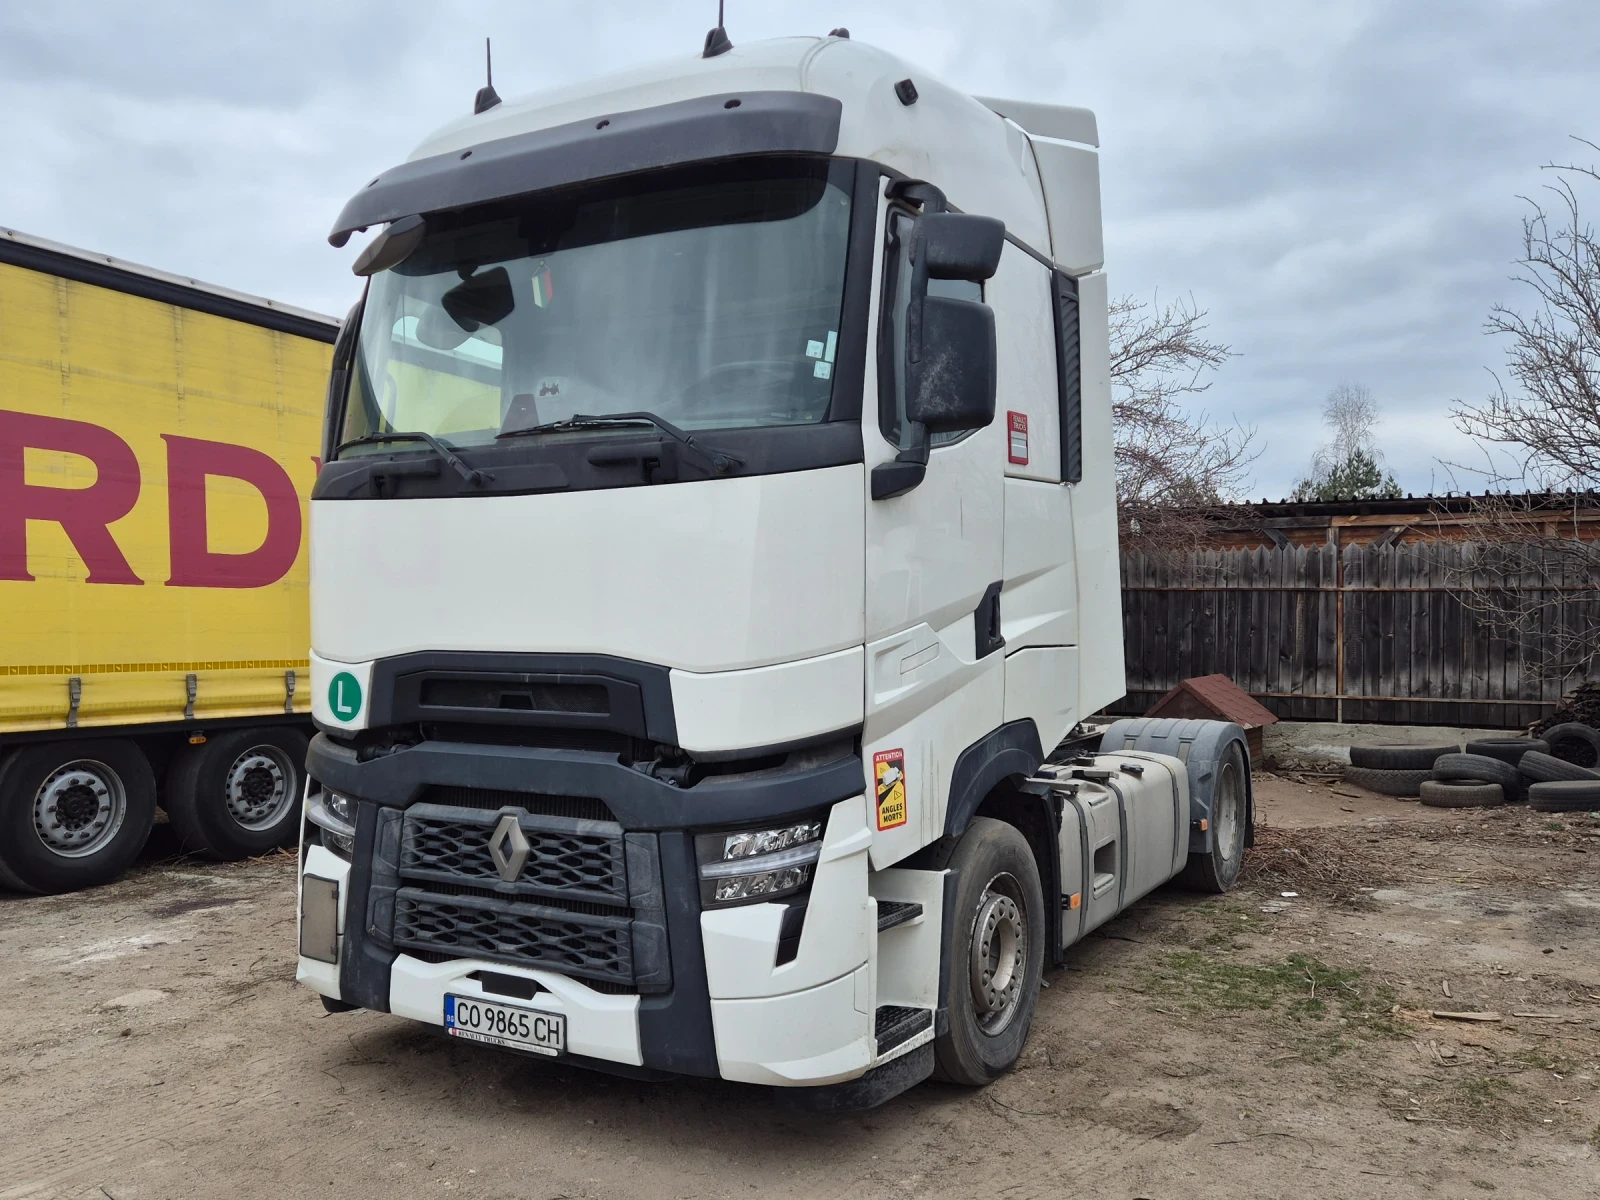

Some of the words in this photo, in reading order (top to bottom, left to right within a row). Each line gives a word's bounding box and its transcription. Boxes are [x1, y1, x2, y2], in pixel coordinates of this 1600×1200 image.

[0, 409, 321, 589] RD
[338, 680, 352, 713] L
[876, 751, 903, 762] ATTENTION
[882, 803, 903, 814] ANGLES
[883, 812, 902, 823] MORTS
[484, 1007, 530, 1038] 9865
[534, 1017, 560, 1045] CH
